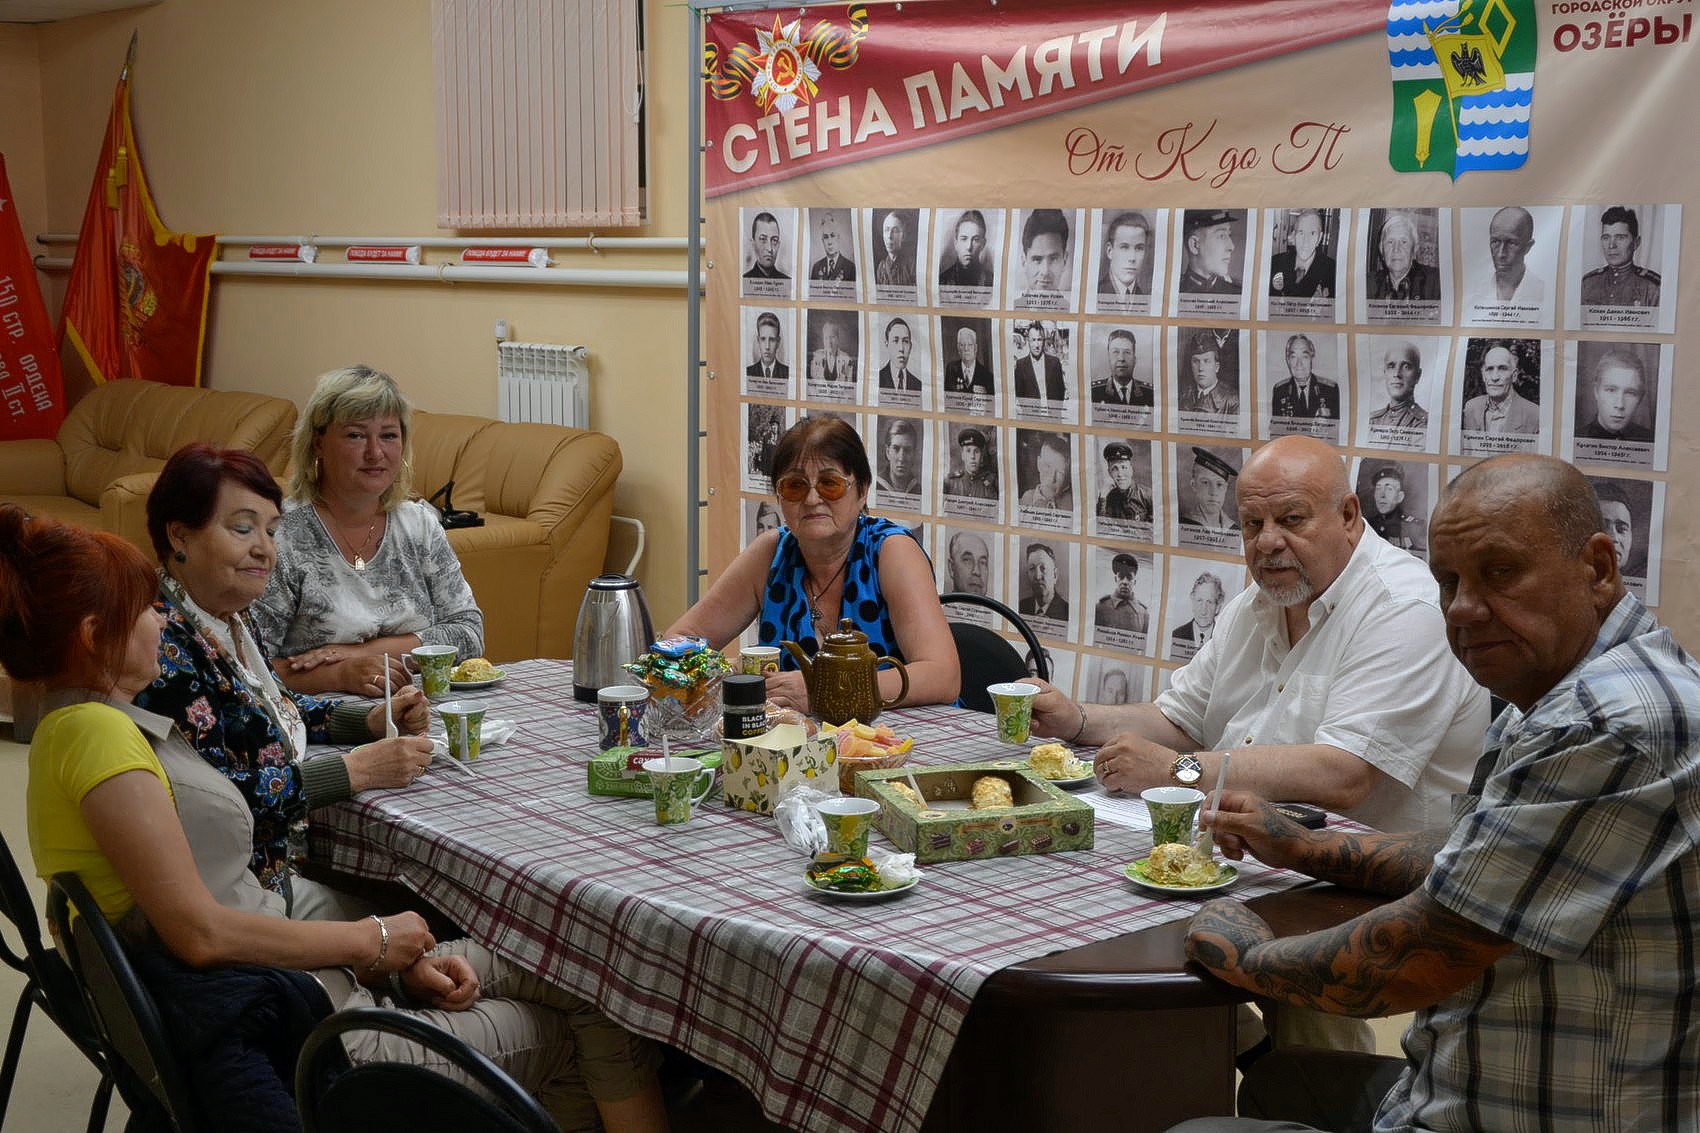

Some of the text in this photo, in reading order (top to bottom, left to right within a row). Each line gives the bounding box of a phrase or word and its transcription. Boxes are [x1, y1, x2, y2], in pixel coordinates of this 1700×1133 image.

[1553, 11, 1692, 52] ОЗЁРЫ
[722, 13, 1168, 173] СТЕНА ПАМЯТИ
[1066, 120, 1353, 188] От К до П
[0, 276, 18, 307] 150
[19, 353, 53, 412] ОРДЕНА
[742, 714, 764, 722] BLACK
[751, 720, 768, 728] BLAC
